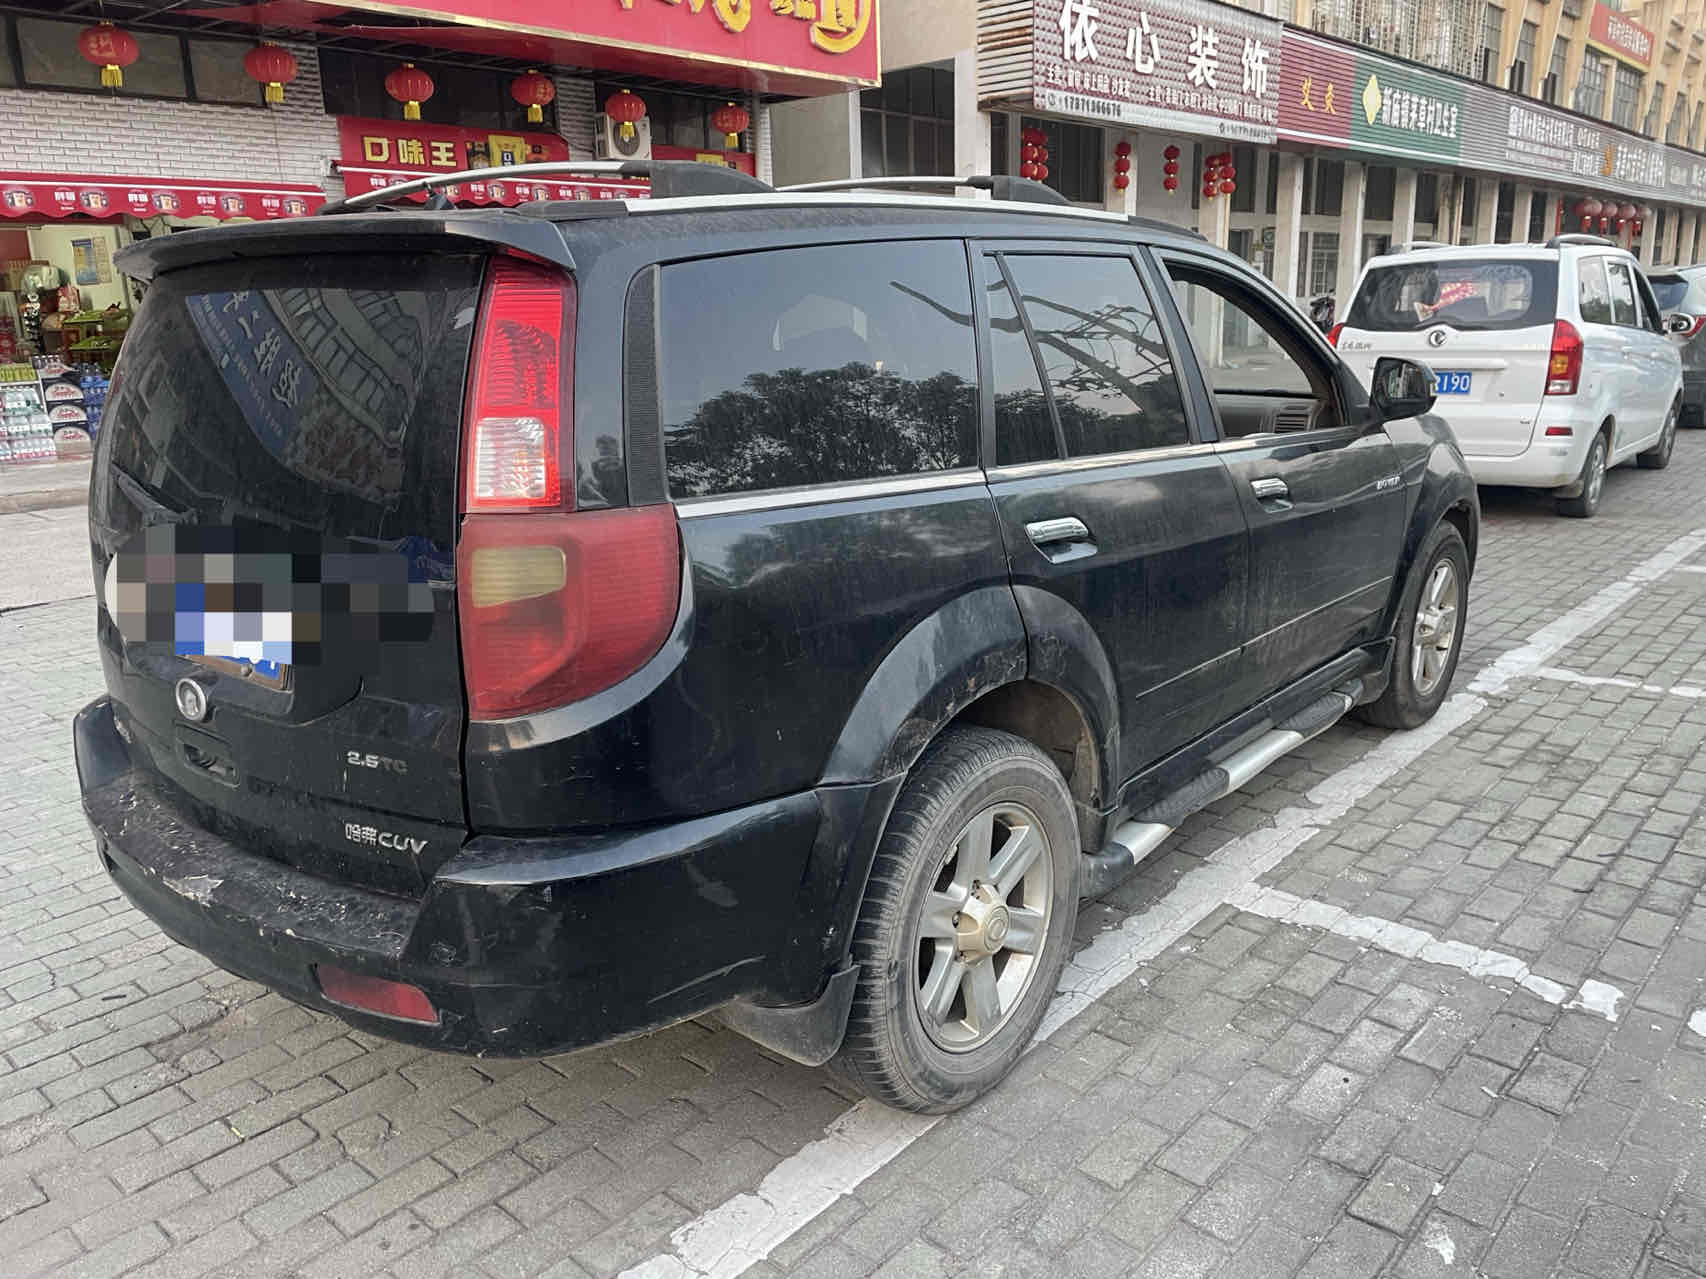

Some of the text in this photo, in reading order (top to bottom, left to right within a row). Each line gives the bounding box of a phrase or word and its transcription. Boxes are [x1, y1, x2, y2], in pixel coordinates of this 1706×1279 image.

[1058, 0, 1270, 98] 依心装饰
[362, 136, 458, 168] 口味王
